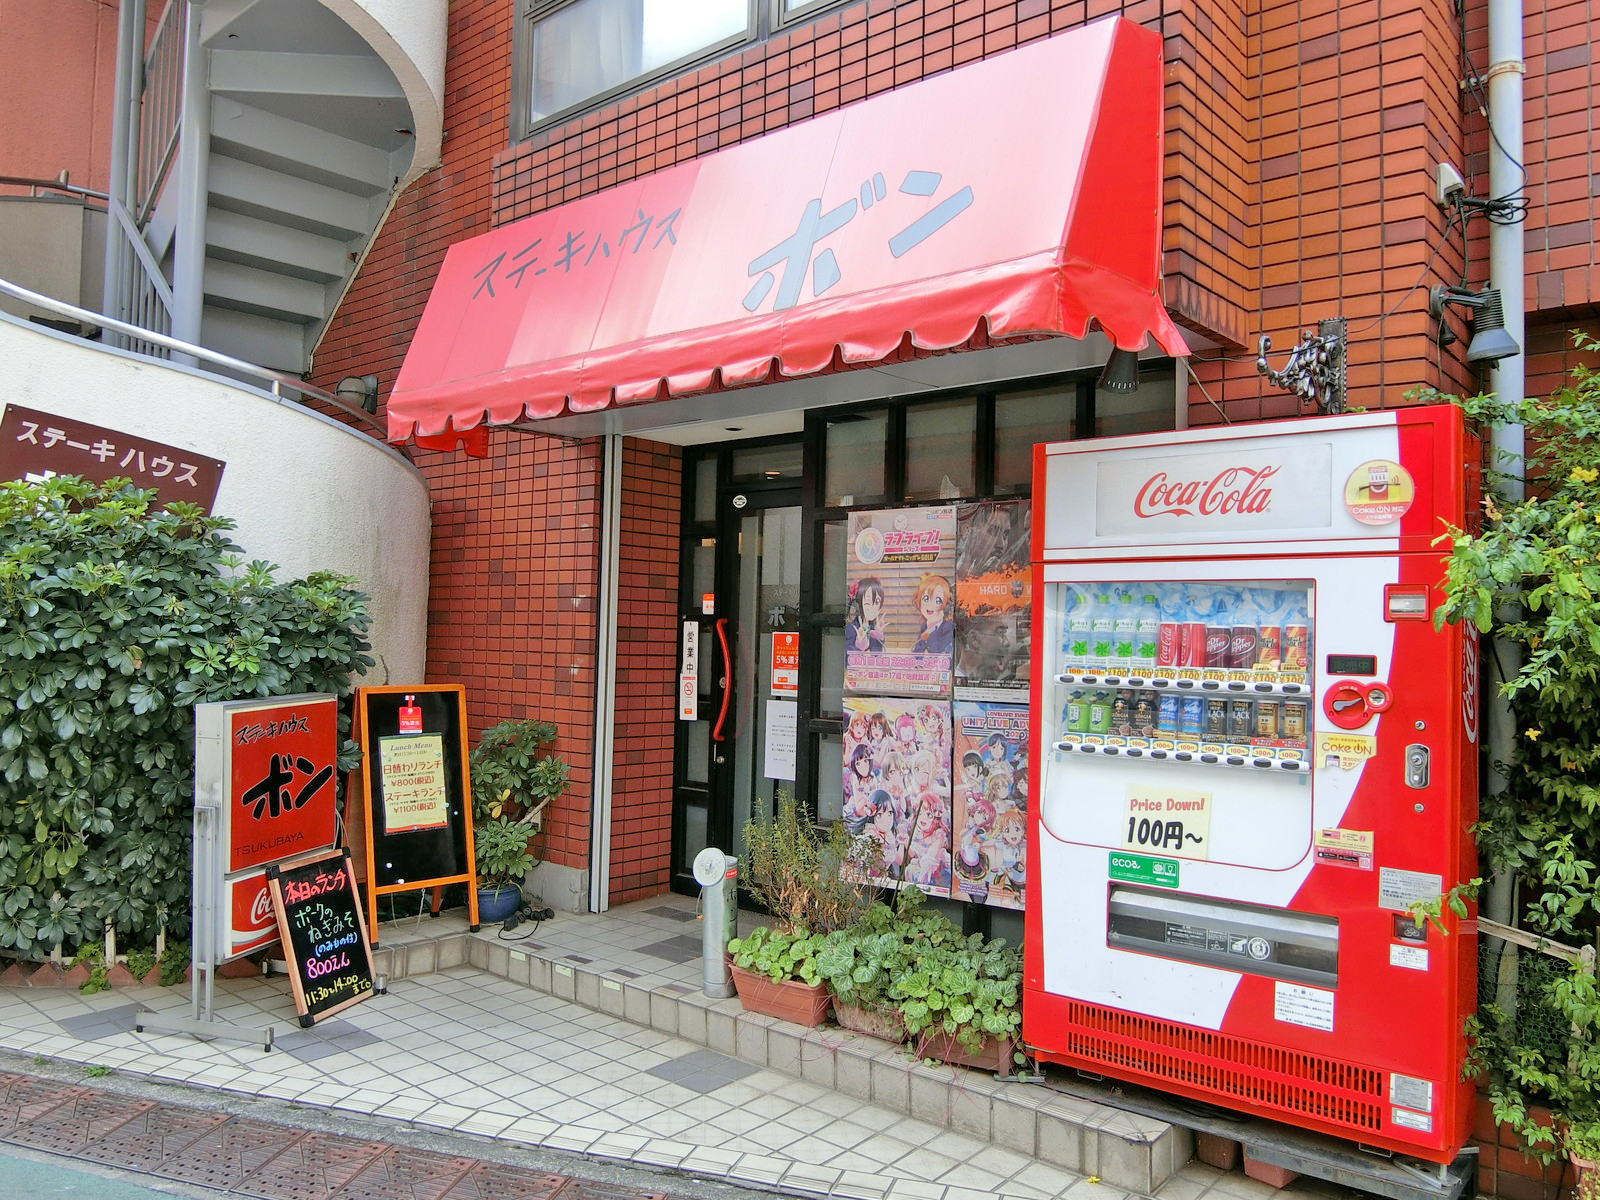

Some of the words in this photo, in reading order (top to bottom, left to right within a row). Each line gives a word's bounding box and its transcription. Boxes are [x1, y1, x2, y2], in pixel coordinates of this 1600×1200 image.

[742, 170, 974, 312] ボン
[473, 208, 682, 301] ステーキハウス
[17, 421, 199, 487] ステーキハウス
[1134, 465, 1282, 519] Coca-Cola
[885, 530, 940, 546] ラブライブ!
[980, 585, 1007, 595] HARD
[235, 713, 310, 746] ステーキハウス
[963, 717, 985, 726] UNIT
[988, 718, 1009, 727] LIVE
[1005, 730, 1025, 738] 2020
[1322, 742, 1351, 753] Coke
[1353, 743, 1372, 755] ON
[383, 760, 442, 774] 日替わりランチ
[241, 753, 333, 820] ボン
[1130, 798, 1162, 811] Price
[1166, 798, 1205, 811] Down!
[234, 831, 304, 857] TSUKUBAYA
[285, 868, 347, 904] 本日のランチ
[295, 903, 333, 929] ポークの
[308, 911, 355, 944] ねぎみそ
[306, 951, 350, 978] 800えん
